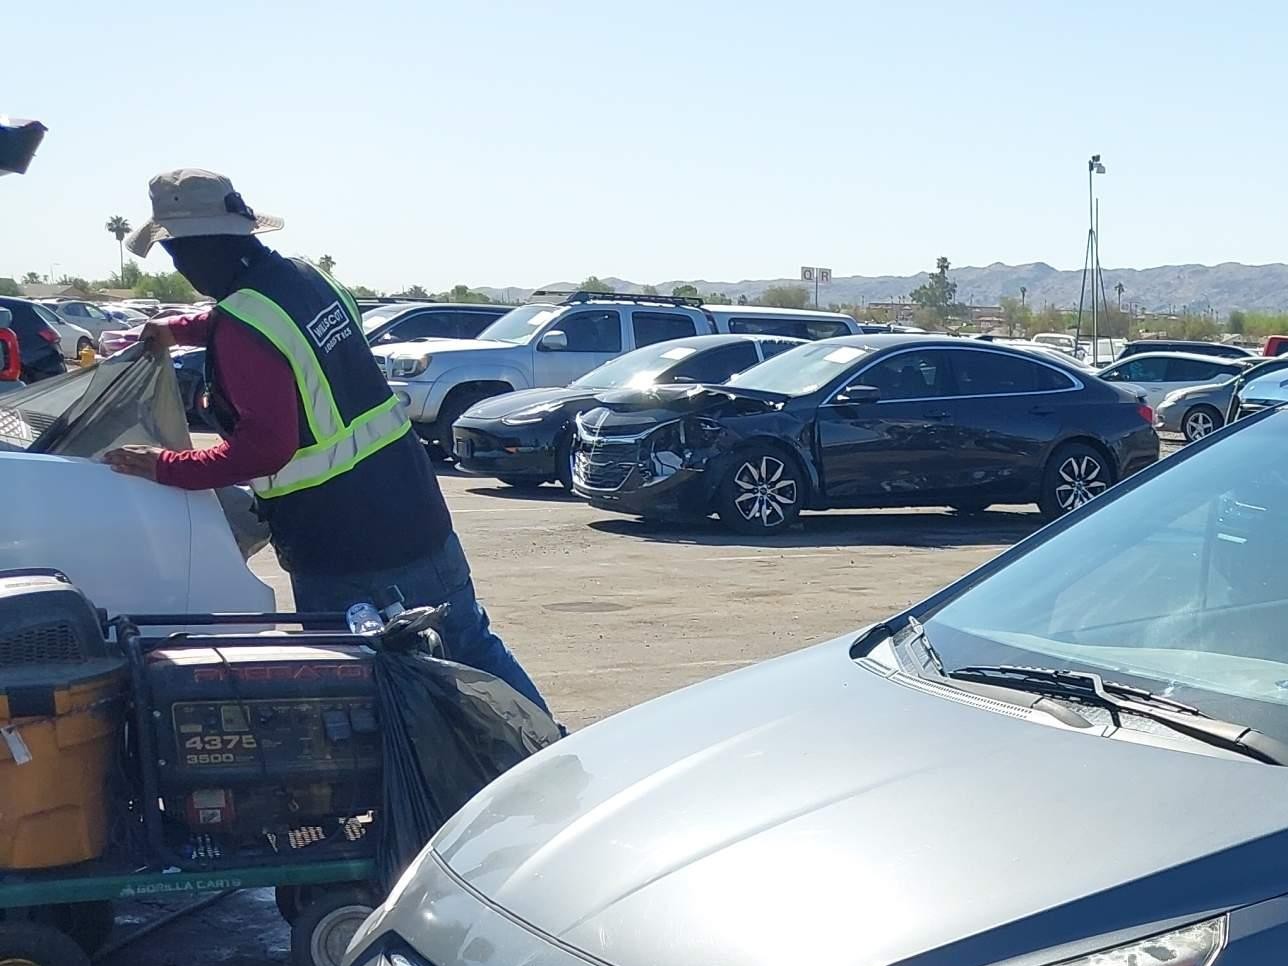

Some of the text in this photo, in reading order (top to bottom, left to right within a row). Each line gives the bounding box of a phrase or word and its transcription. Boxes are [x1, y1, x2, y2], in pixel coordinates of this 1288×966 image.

[821, 271, 829, 281] R
[185, 735, 257, 750] 4375
[186, 754, 234, 765] 3500
[136, 881, 193, 894] GORILLA
